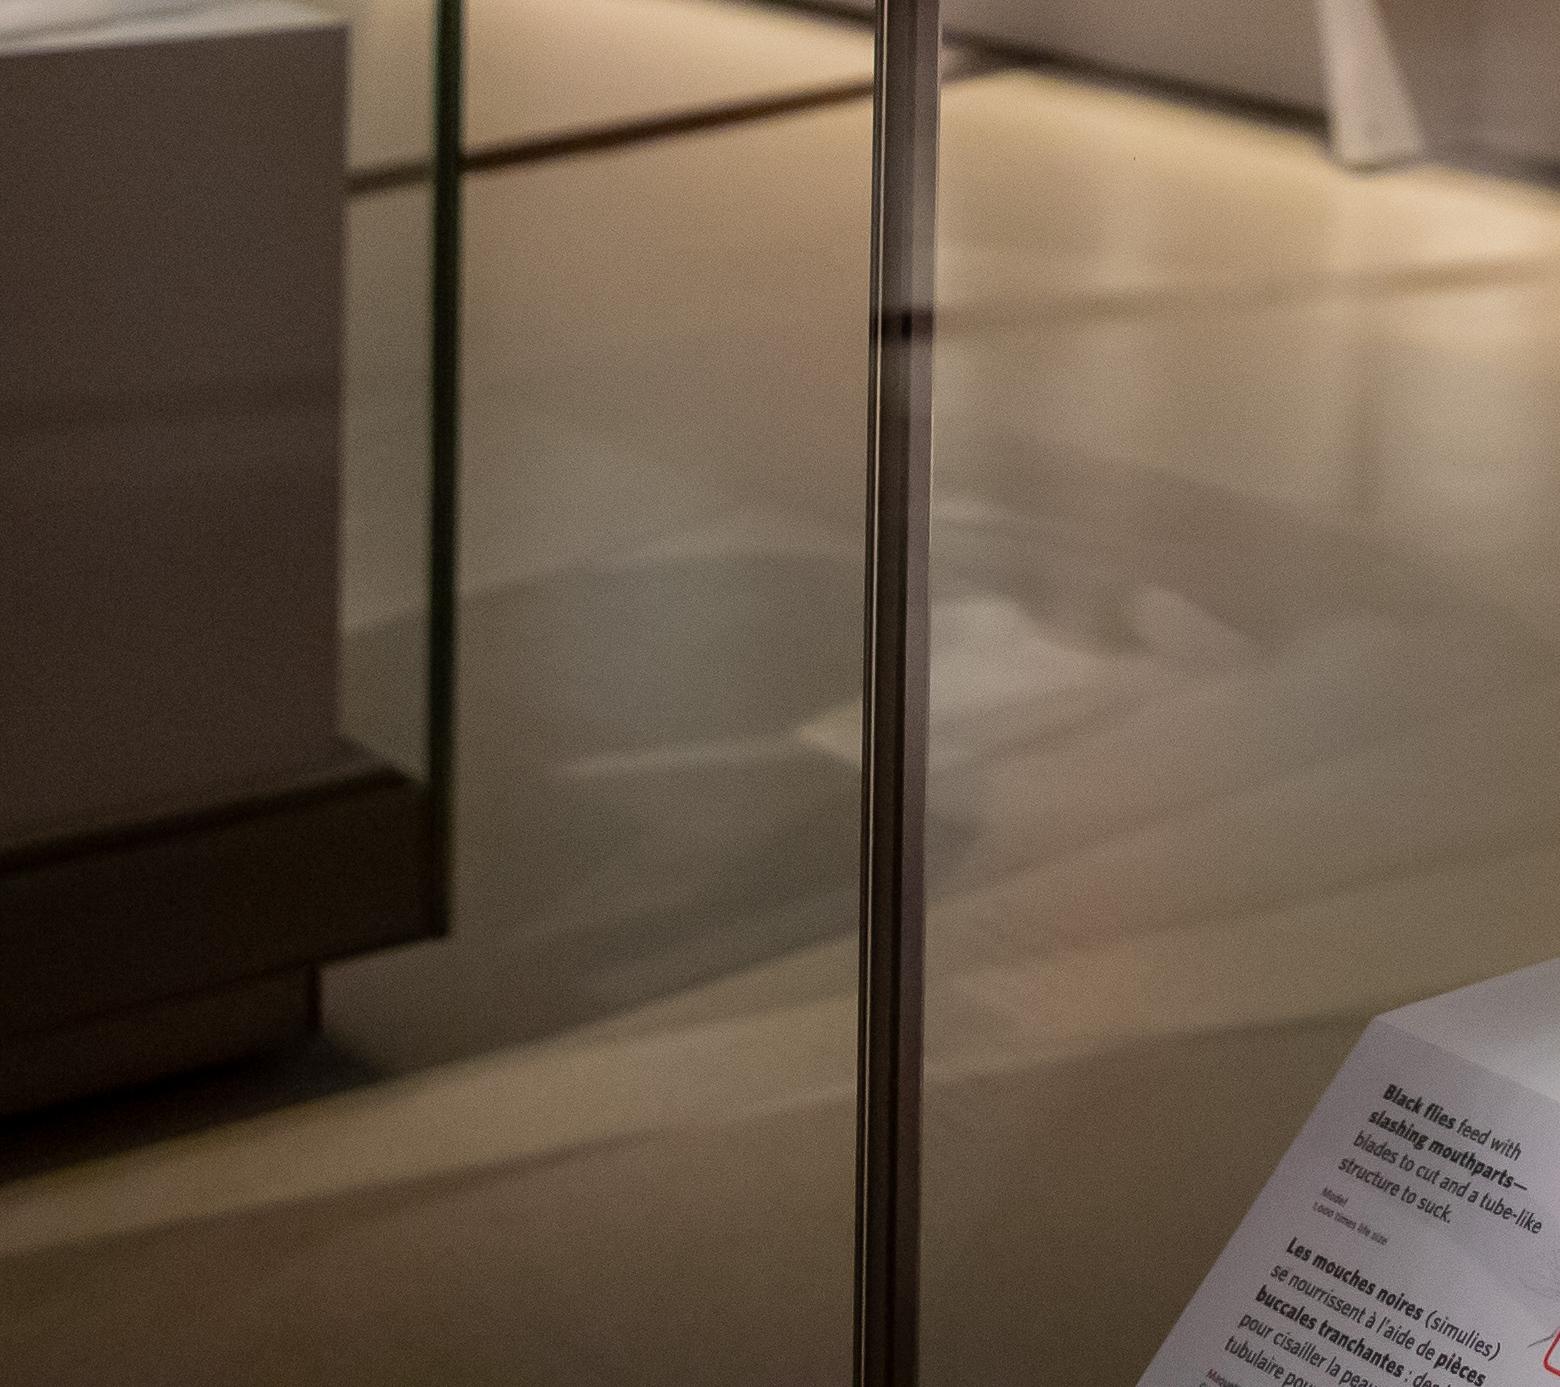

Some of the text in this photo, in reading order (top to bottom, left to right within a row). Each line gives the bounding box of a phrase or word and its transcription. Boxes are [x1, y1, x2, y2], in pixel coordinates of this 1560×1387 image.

[1368, 1109, 1528, 1191] slashing mouthparts—
[1382, 1084, 1522, 1162] Black flies feed with
[1338, 1156, 1453, 1225] structure to suck.
[1353, 1129, 1542, 1235] blades to cut and a tube-like
[1255, 1284, 1318, 1330] buccales
[1317, 1319, 1405, 1378] tranchantes
[1270, 1264, 1289, 1282] se
[1288, 1274, 1366, 1324] nourrissent
[1364, 1310, 1377, 1329] à
[1415, 1339, 1436, 1361] de
[1433, 1352, 1487, 1387] pièces
[1286, 1236, 1501, 1362] Les mouches noires (simulies)
[1223, 1335, 1285, 1380] tubulaire
[1238, 1313, 1274, 1339] pour
[1272, 1331, 1327, 1368] cisailler
[1325, 1356, 1341, 1377] la
